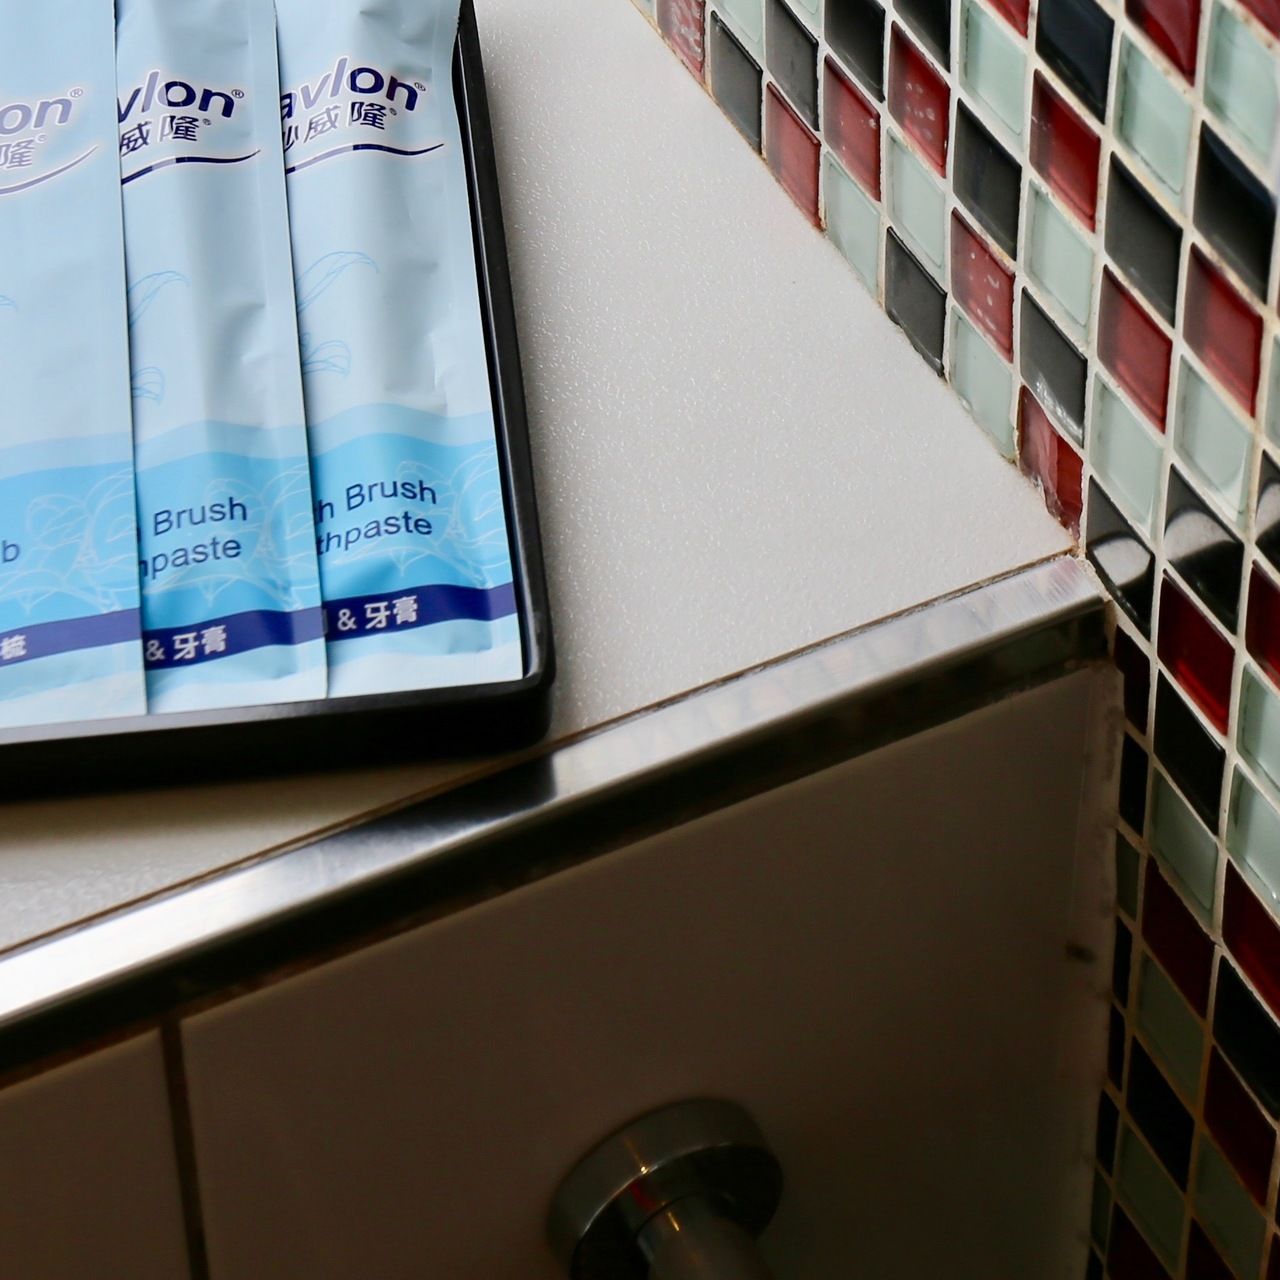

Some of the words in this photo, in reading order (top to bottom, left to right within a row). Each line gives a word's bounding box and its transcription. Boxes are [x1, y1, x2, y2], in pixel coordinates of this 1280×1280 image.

[117, 70, 236, 125] vlon
[280, 57, 419, 120] avlon
[120, 115, 201, 158] 威隆
[153, 496, 248, 537] Brush
[345, 479, 437, 512] Brush
[315, 511, 433, 556] thpaste
[336, 607, 358, 631] &
[364, 594, 419, 630] 牙膏
[145, 639, 166, 662] &
[172, 624, 228, 661] 牙膏
